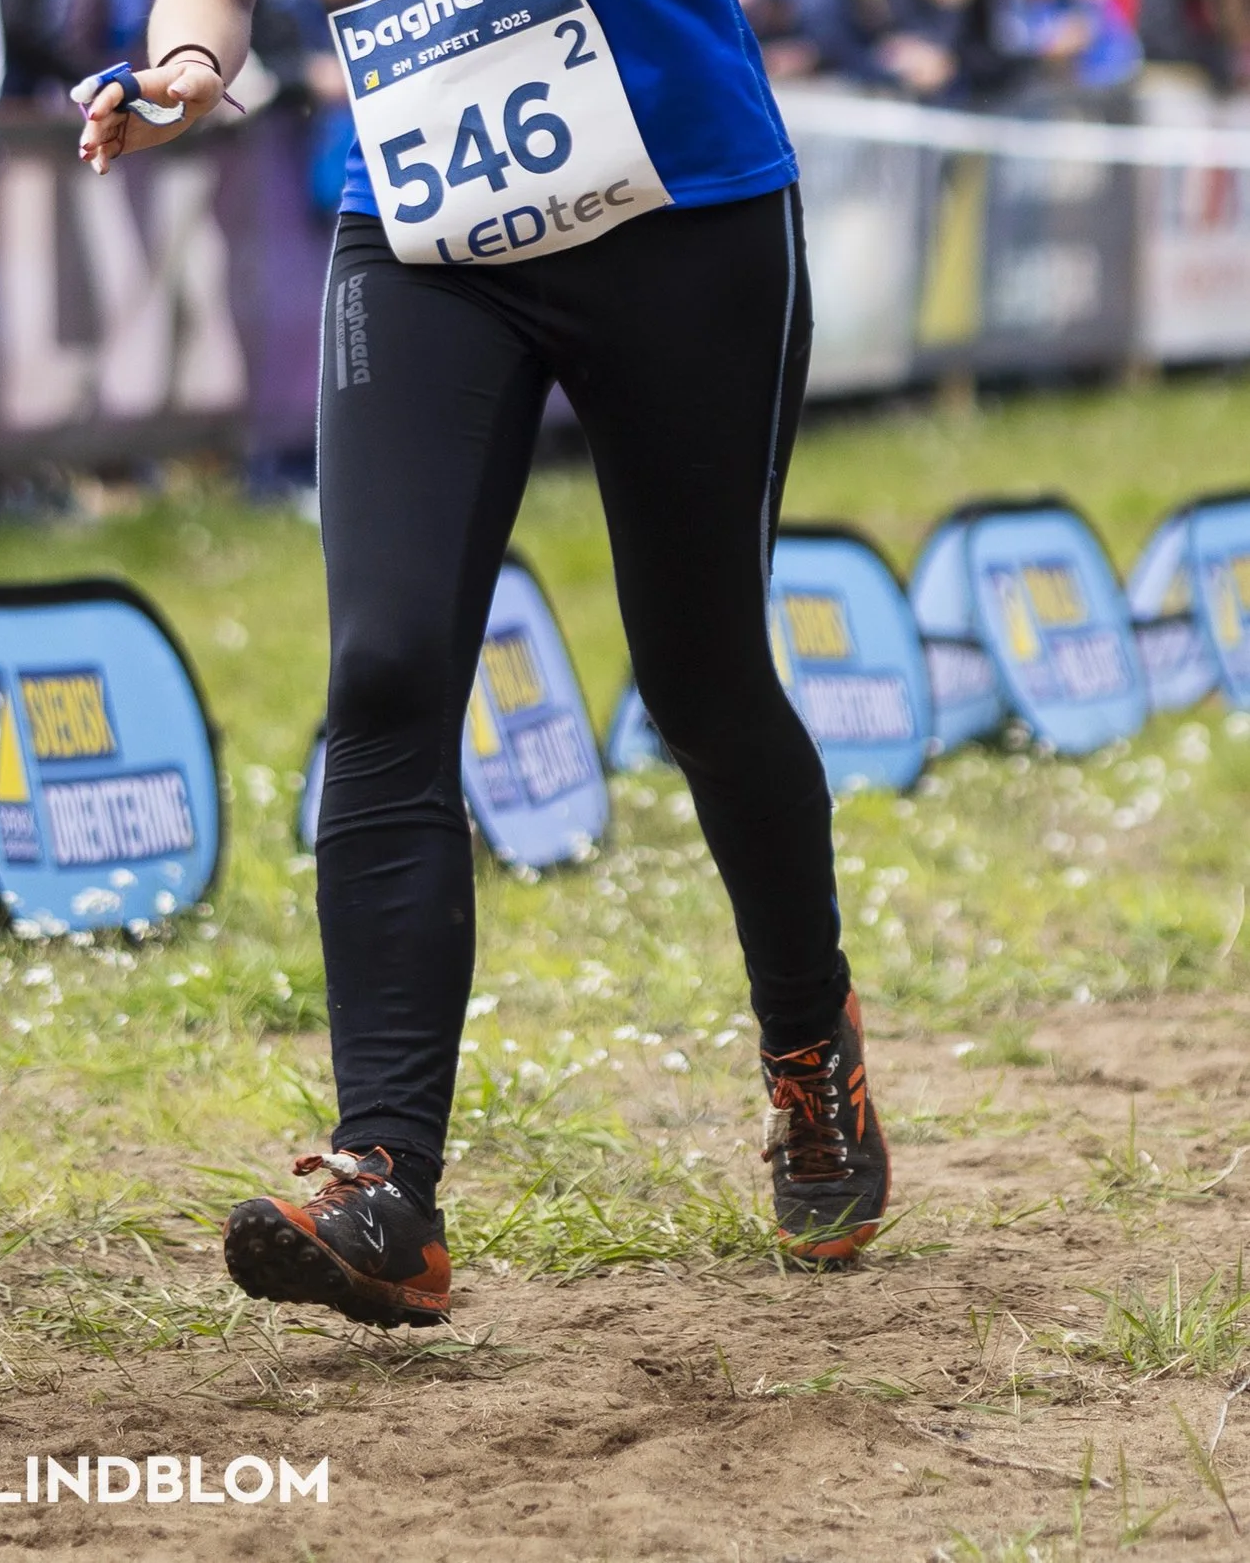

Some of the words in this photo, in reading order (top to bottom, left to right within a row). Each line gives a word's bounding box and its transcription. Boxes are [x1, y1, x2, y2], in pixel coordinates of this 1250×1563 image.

[392, 60, 412, 77] SM
[418, 28, 481, 65] STAFETT
[491, 9, 532, 35] 2025
[554, 19, 597, 70] 2
[379, 81, 573, 224] 546
[436, 178, 635, 265] LEDtec
[346, 272, 371, 385] bagheera
